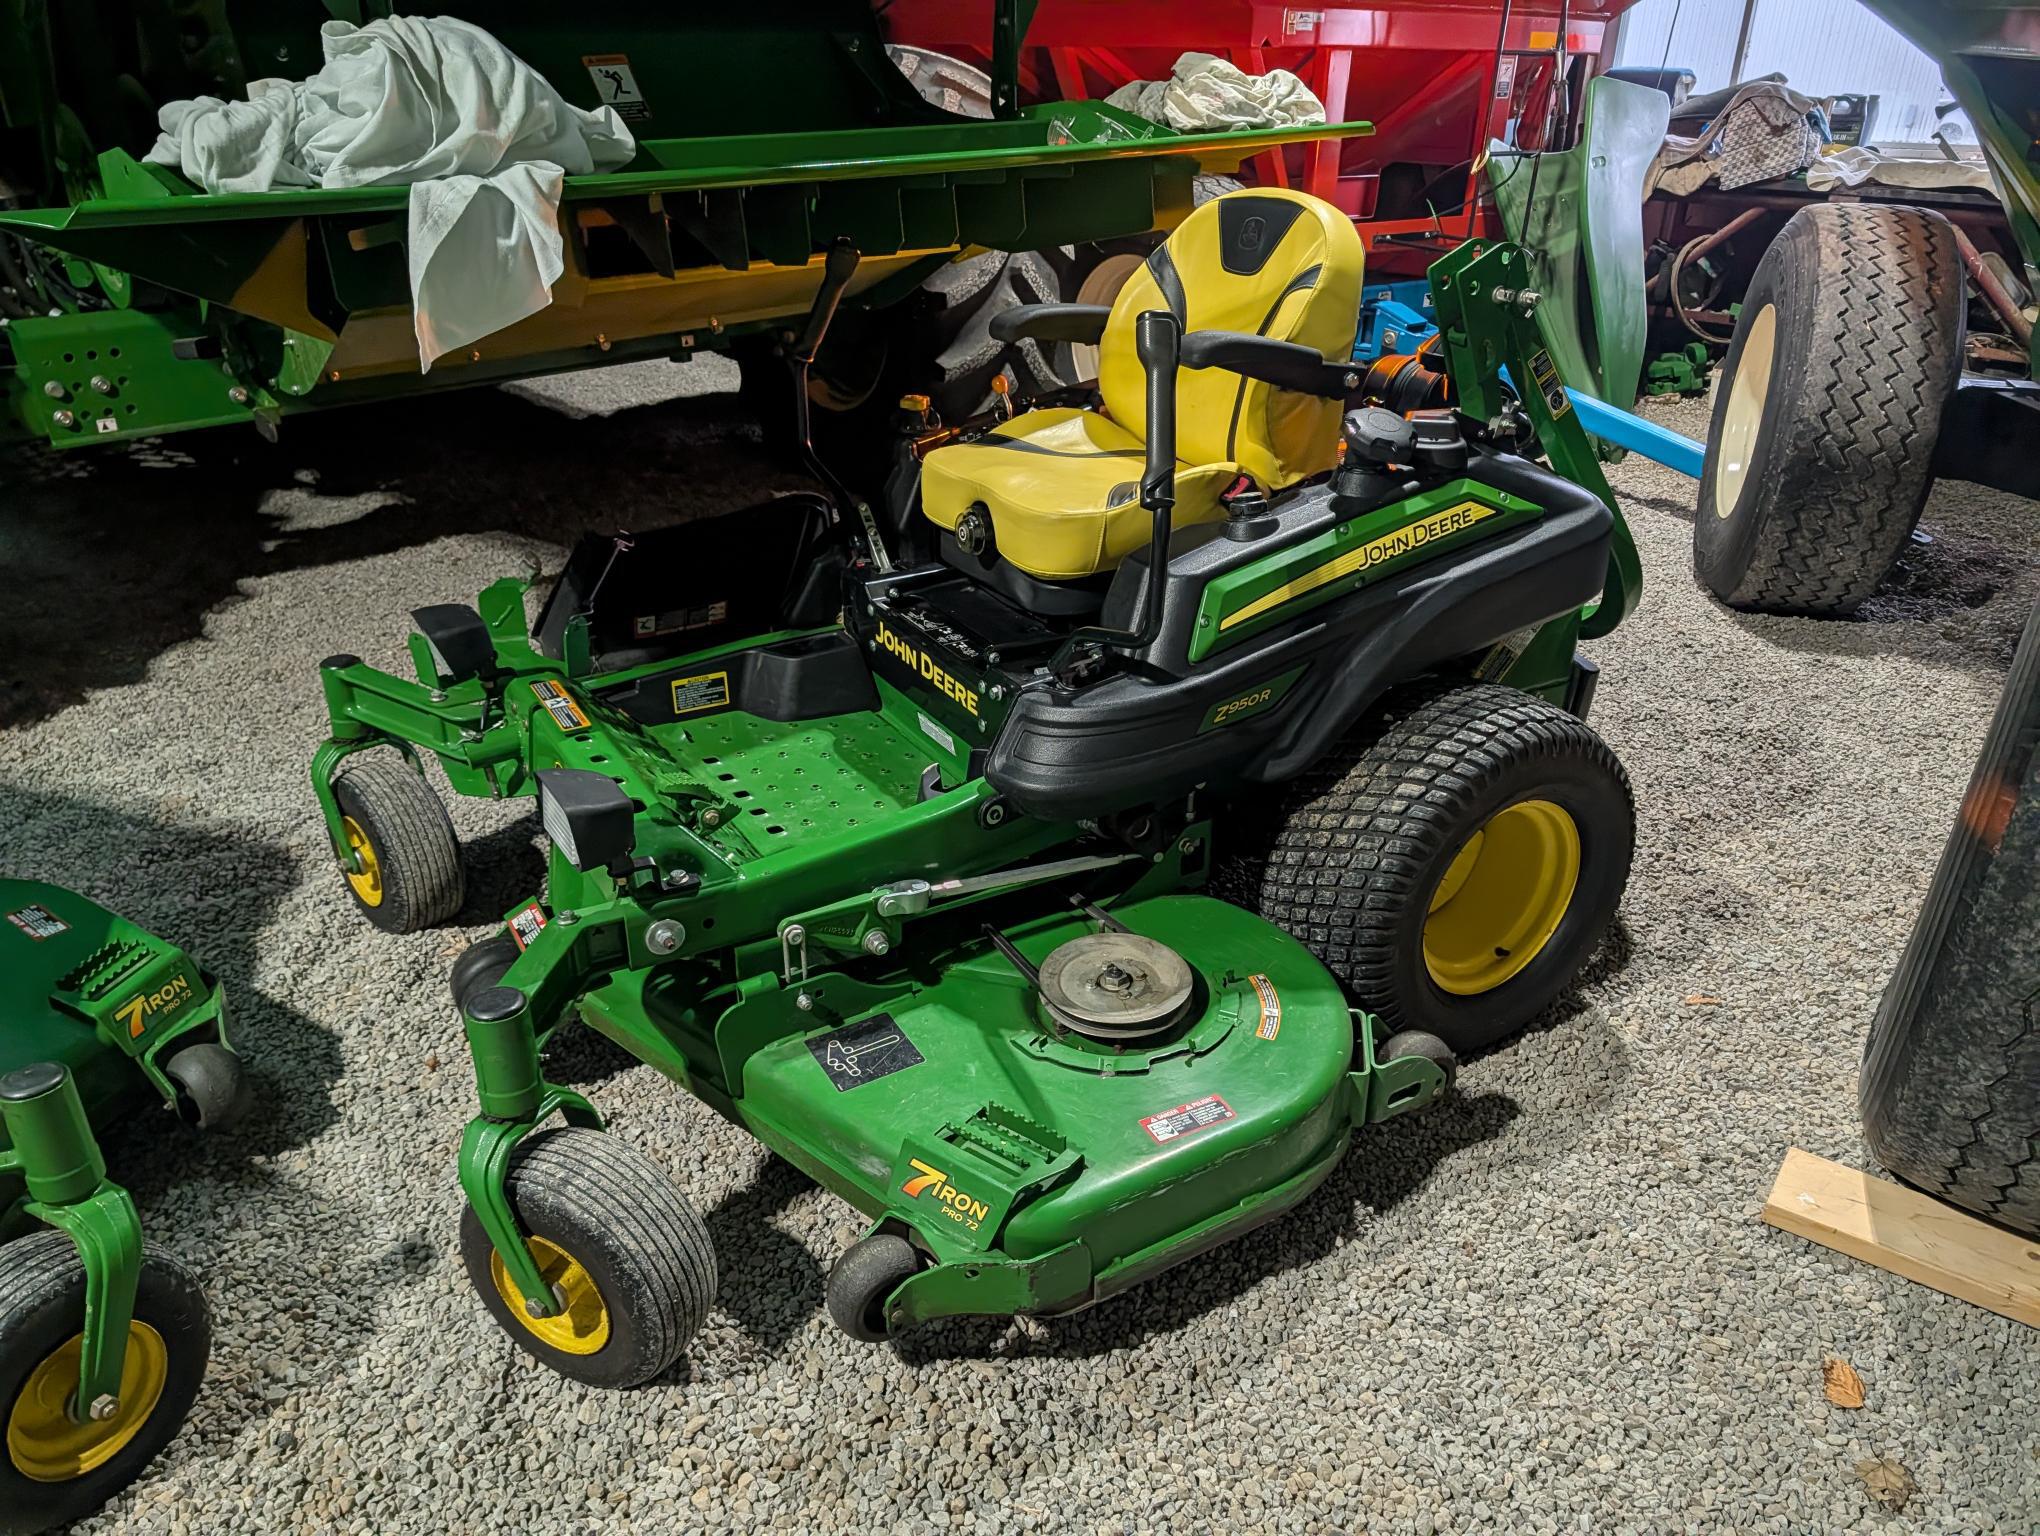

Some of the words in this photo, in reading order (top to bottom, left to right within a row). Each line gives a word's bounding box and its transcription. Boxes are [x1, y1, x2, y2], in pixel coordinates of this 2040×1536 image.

[1358, 533, 1409, 569] JOHN
[1412, 508, 1475, 545] DEERE
[875, 620, 917, 671] JOHN
[920, 651, 979, 717] DEERE
[1213, 688, 1272, 723] Z950R
[162, 998, 181, 1015] PRO
[181, 989, 193, 1001] 72
[941, 1205, 963, 1222] PRO
[965, 1218, 979, 1232] 72
